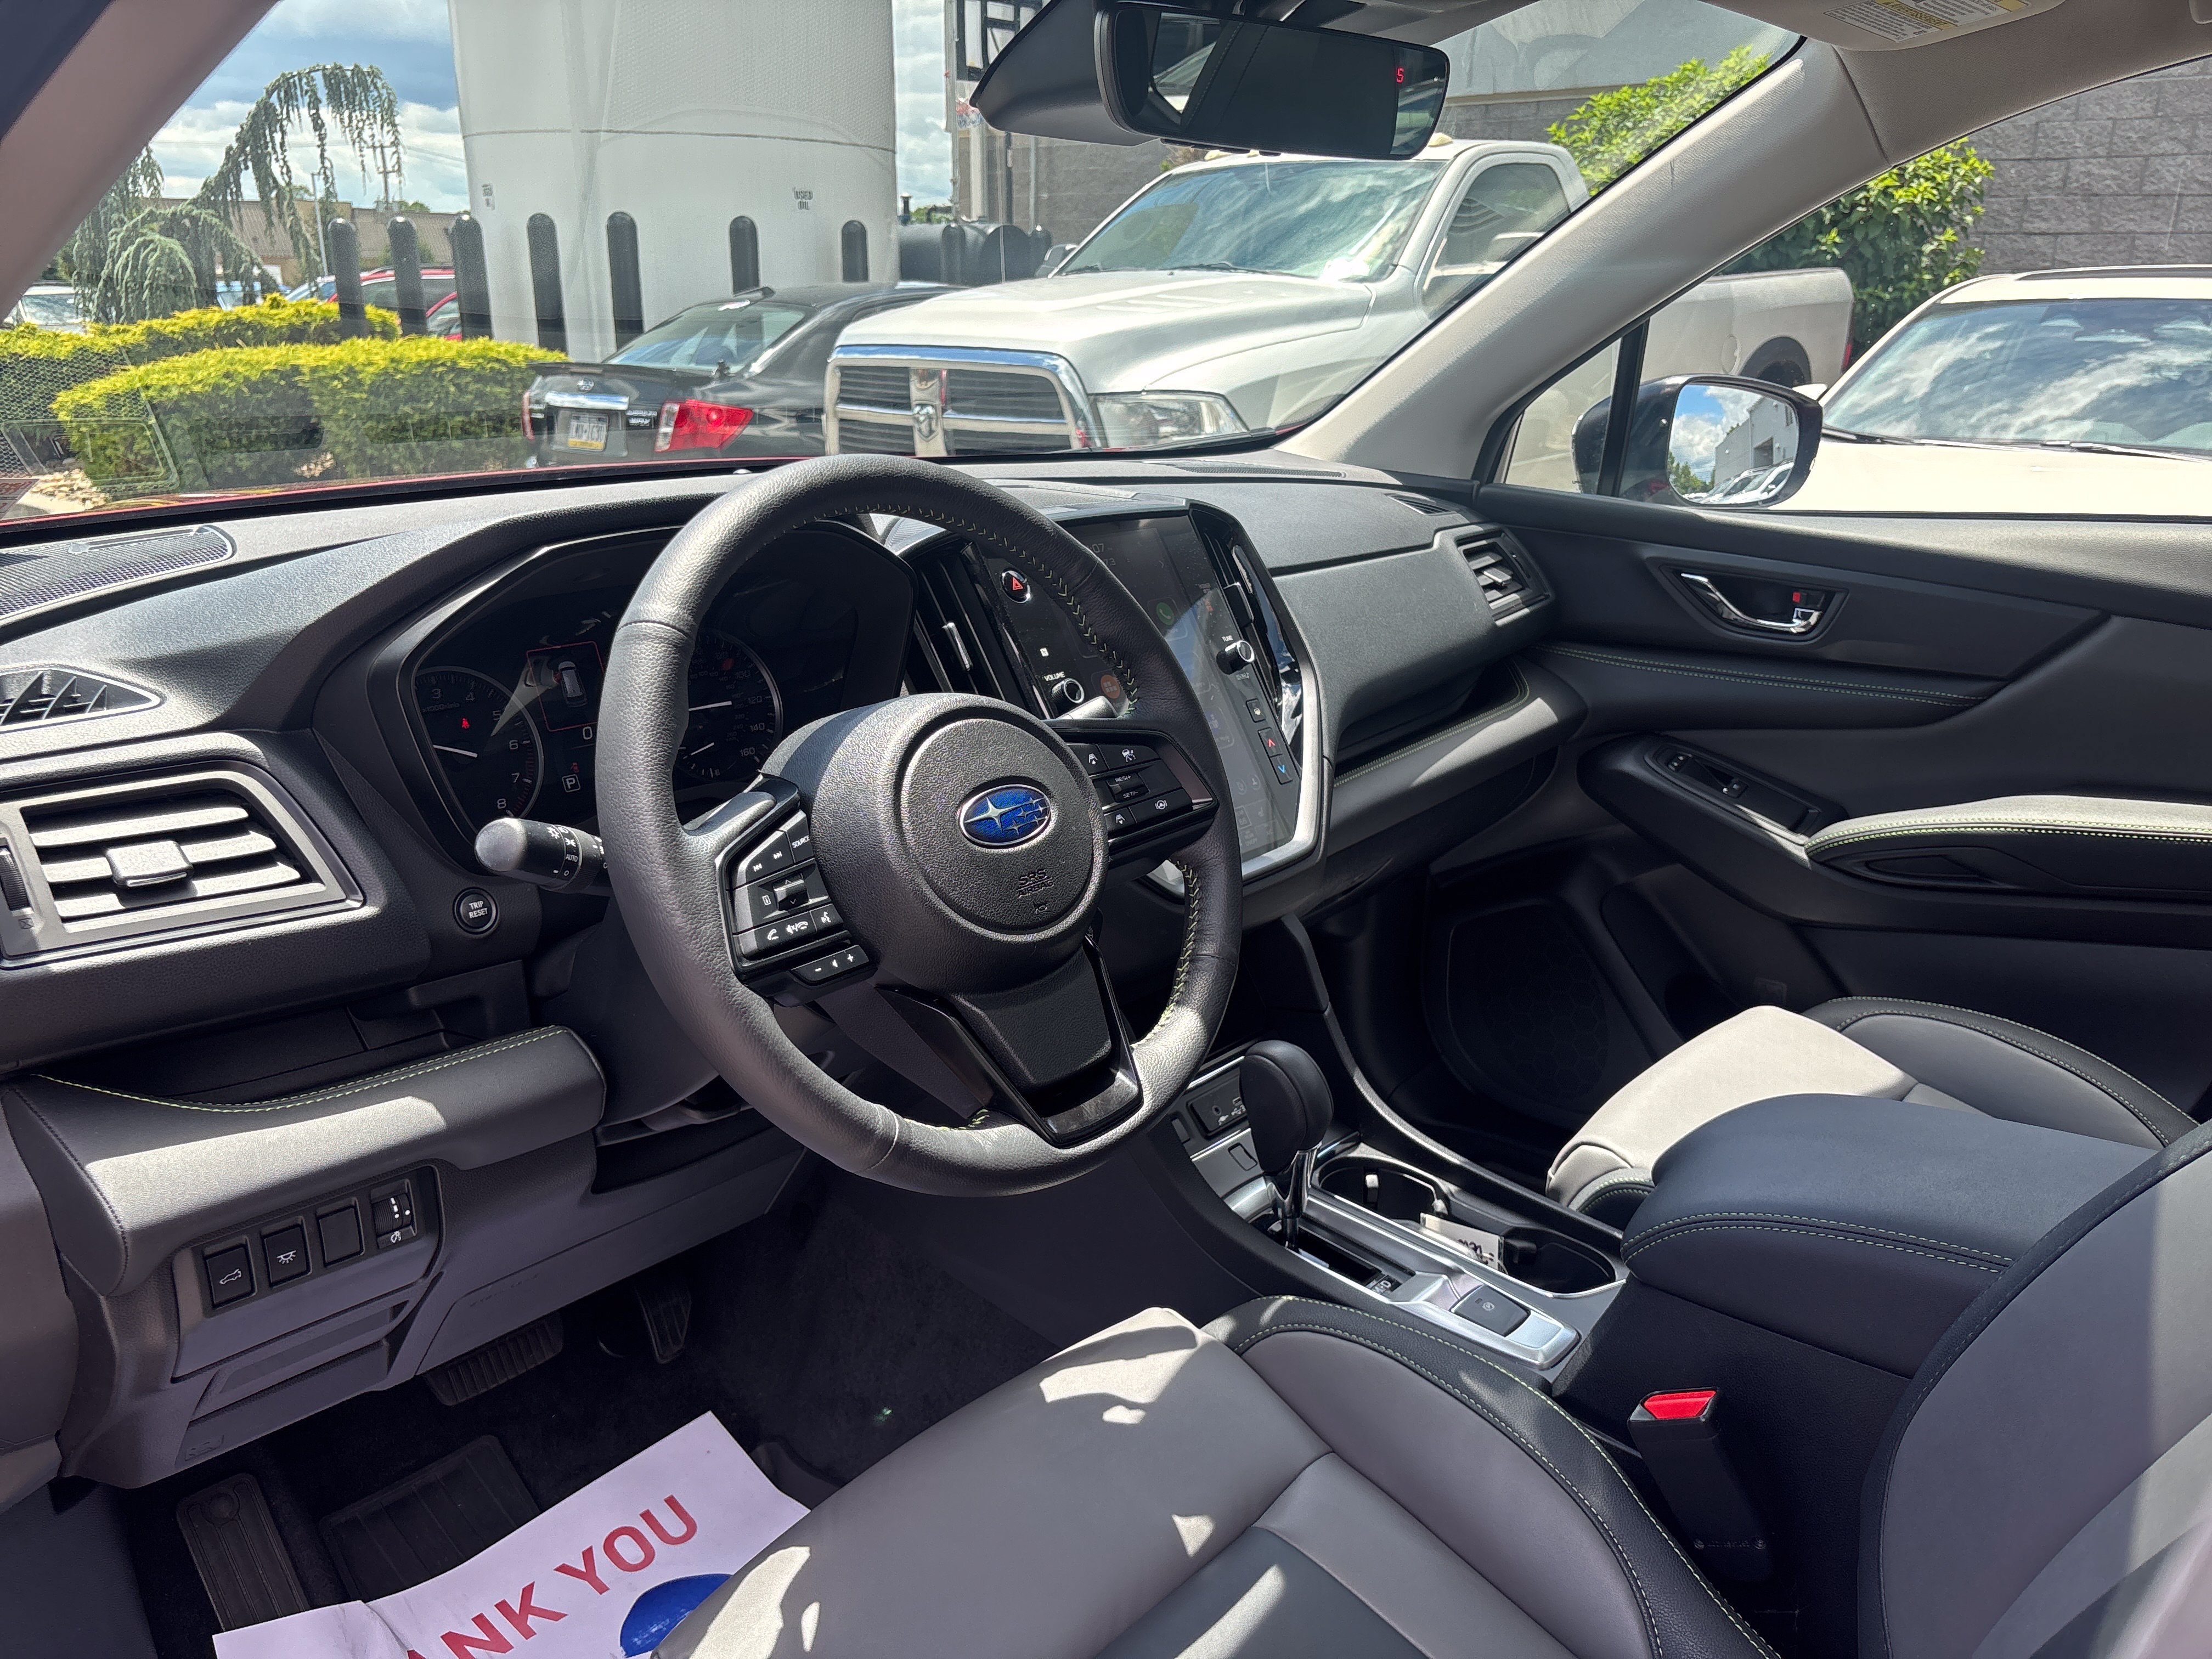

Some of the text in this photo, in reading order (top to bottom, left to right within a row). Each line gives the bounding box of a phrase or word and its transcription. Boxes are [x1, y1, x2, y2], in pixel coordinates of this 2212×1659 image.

[797, 200, 810, 210] OIL
[1044, 673, 1067, 684] VOLUME
[509, 740, 518, 751] 6
[740, 747, 755, 757] 160
[511, 772, 521, 783] 7
[496, 798, 507, 810] 8
[792, 835, 810, 849] SOURCE
[565, 853, 578, 862] AUTO
[1018, 868, 1048, 888] SRS
[1017, 880, 1054, 899] AIRBAG
[469, 900, 484, 909] TRIP
[468, 907, 488, 919] RESET
[406, 1494, 698, 1659] NK YOU
